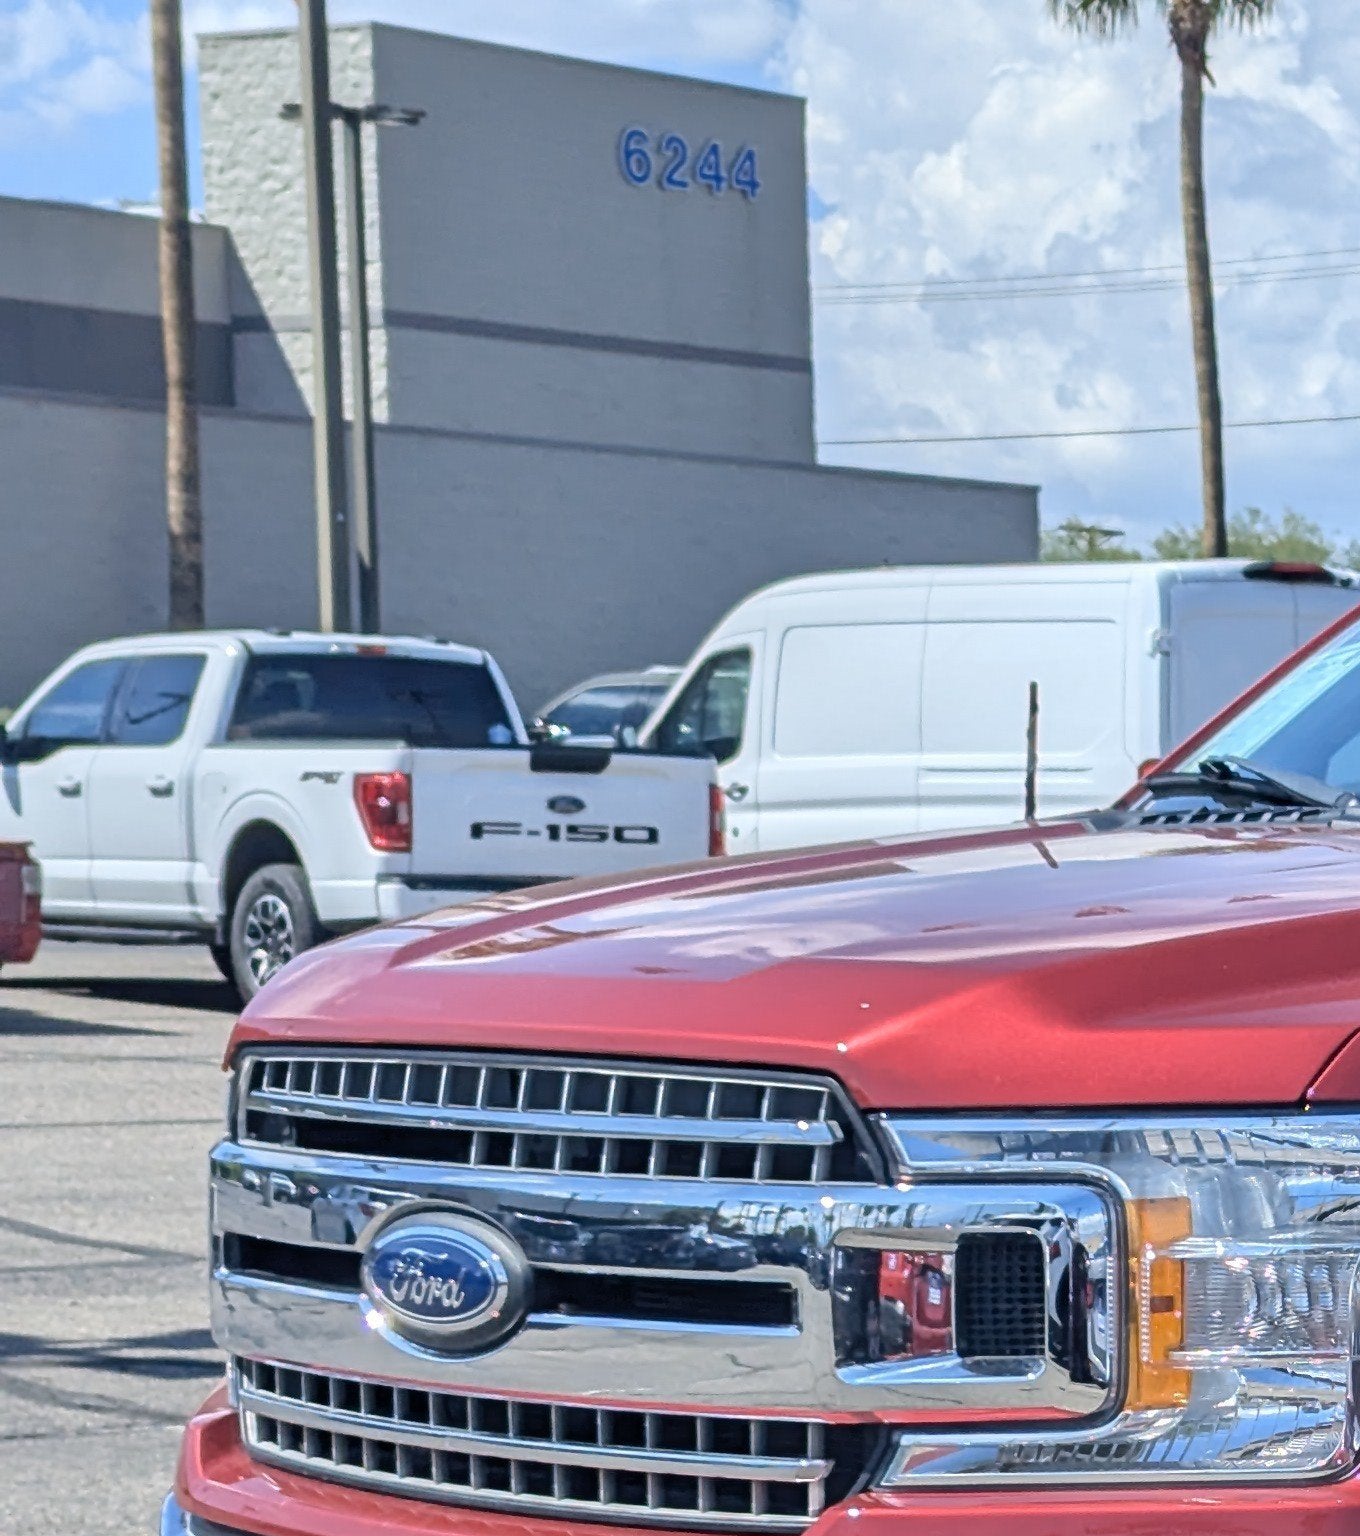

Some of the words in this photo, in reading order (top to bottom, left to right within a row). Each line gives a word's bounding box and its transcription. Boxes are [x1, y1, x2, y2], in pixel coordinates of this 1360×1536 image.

[620, 128, 761, 201] 6244
[470, 821, 660, 845] F-150
[387, 1247, 466, 1309] Ford
